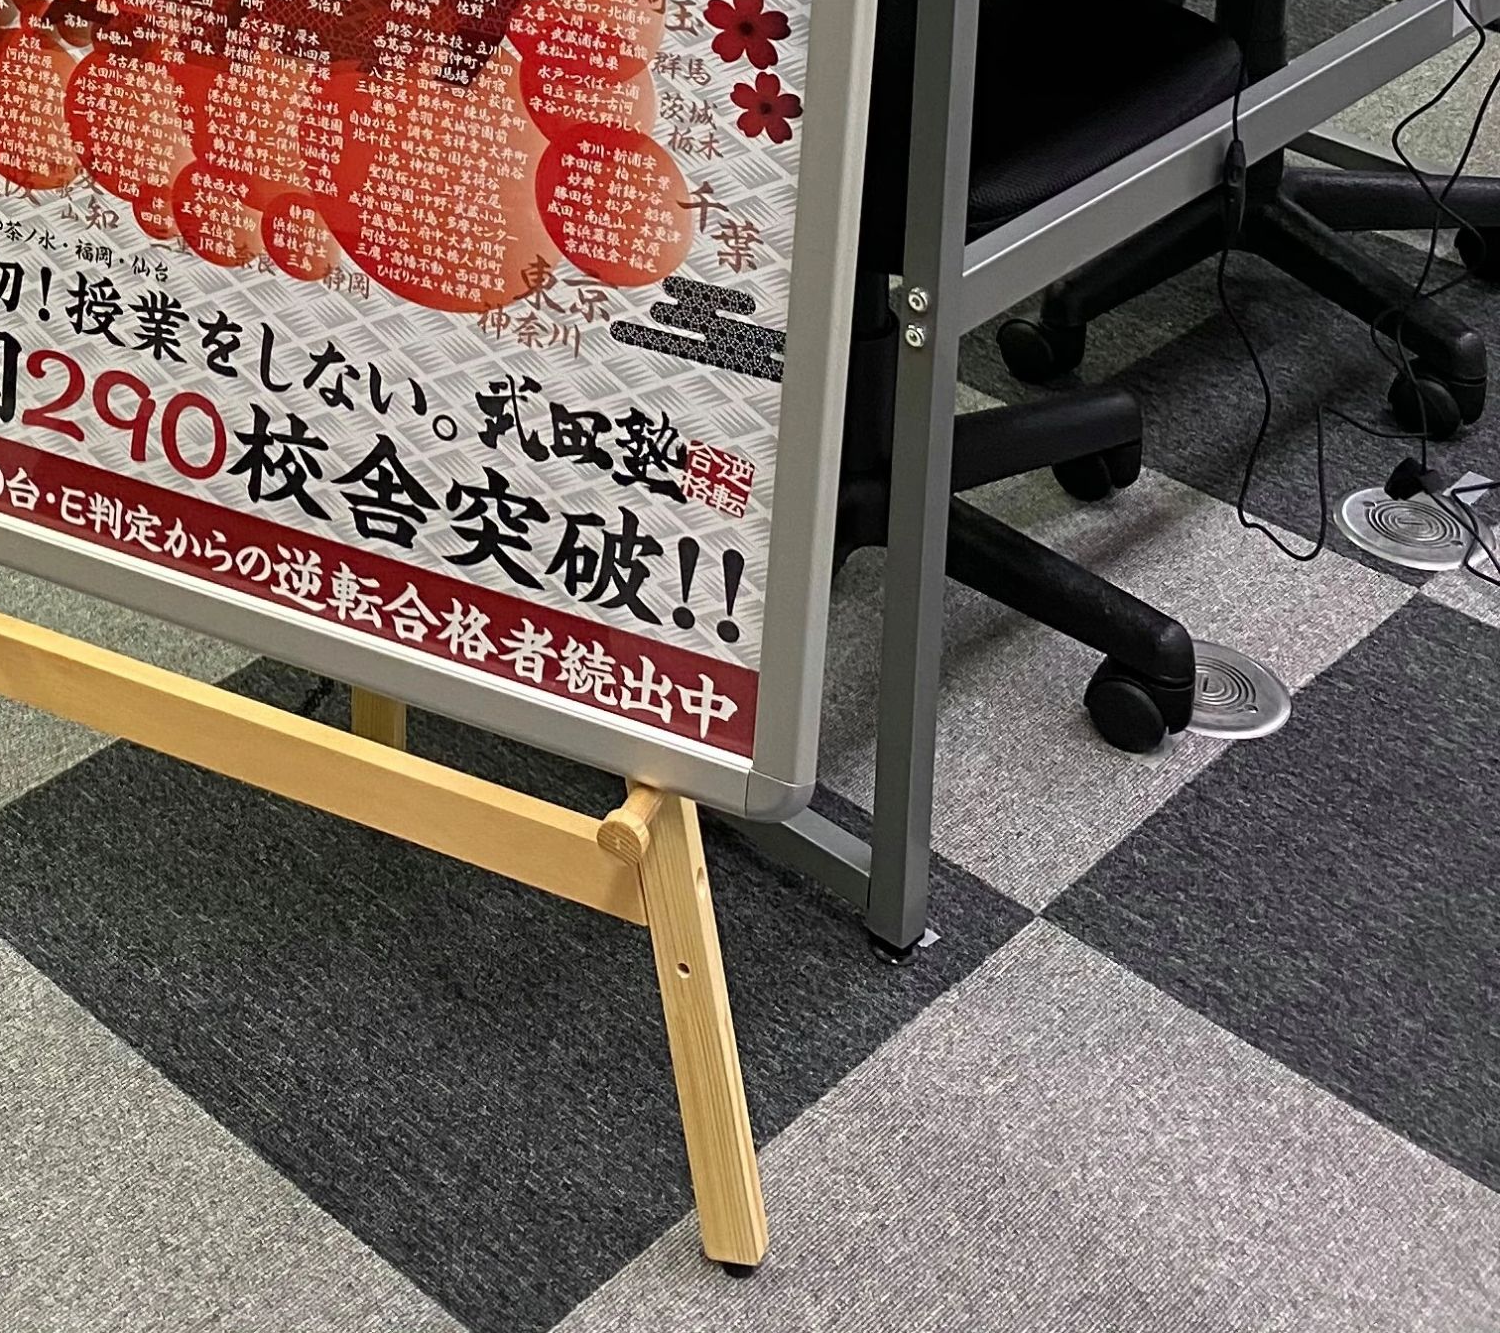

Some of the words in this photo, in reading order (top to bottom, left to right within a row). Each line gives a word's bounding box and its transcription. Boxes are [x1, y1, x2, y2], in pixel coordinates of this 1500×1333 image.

[391, 0, 432, 20] 伊勢崎
[457, 2, 484, 18] 佐野
[64, 14, 87, 28] 高知
[19, 35, 42, 50] 大阪
[97, 28, 132, 47] 和歌山
[6, 48, 52, 68] 河内松原
[651, 52, 712, 86] 群馬
[659, 92, 717, 130] 茨城
[668, 127, 723, 160] 栃木
[190, 173, 249, 198] 奈良西大寺
[195, 191, 244, 211] 大和八木
[141, 212, 174, 228] 四日市
[290, 205, 315, 223] 静岡
[676, 181, 764, 274] 千葉
[200, 237, 236, 259] JR奈良
[287, 255, 312, 271] 三島
[326, 265, 369, 299] 静岡
[514, 254, 618, 323] 東京
[477, 302, 580, 358] 神奈川
[476, 374, 687, 503] 武田塾
